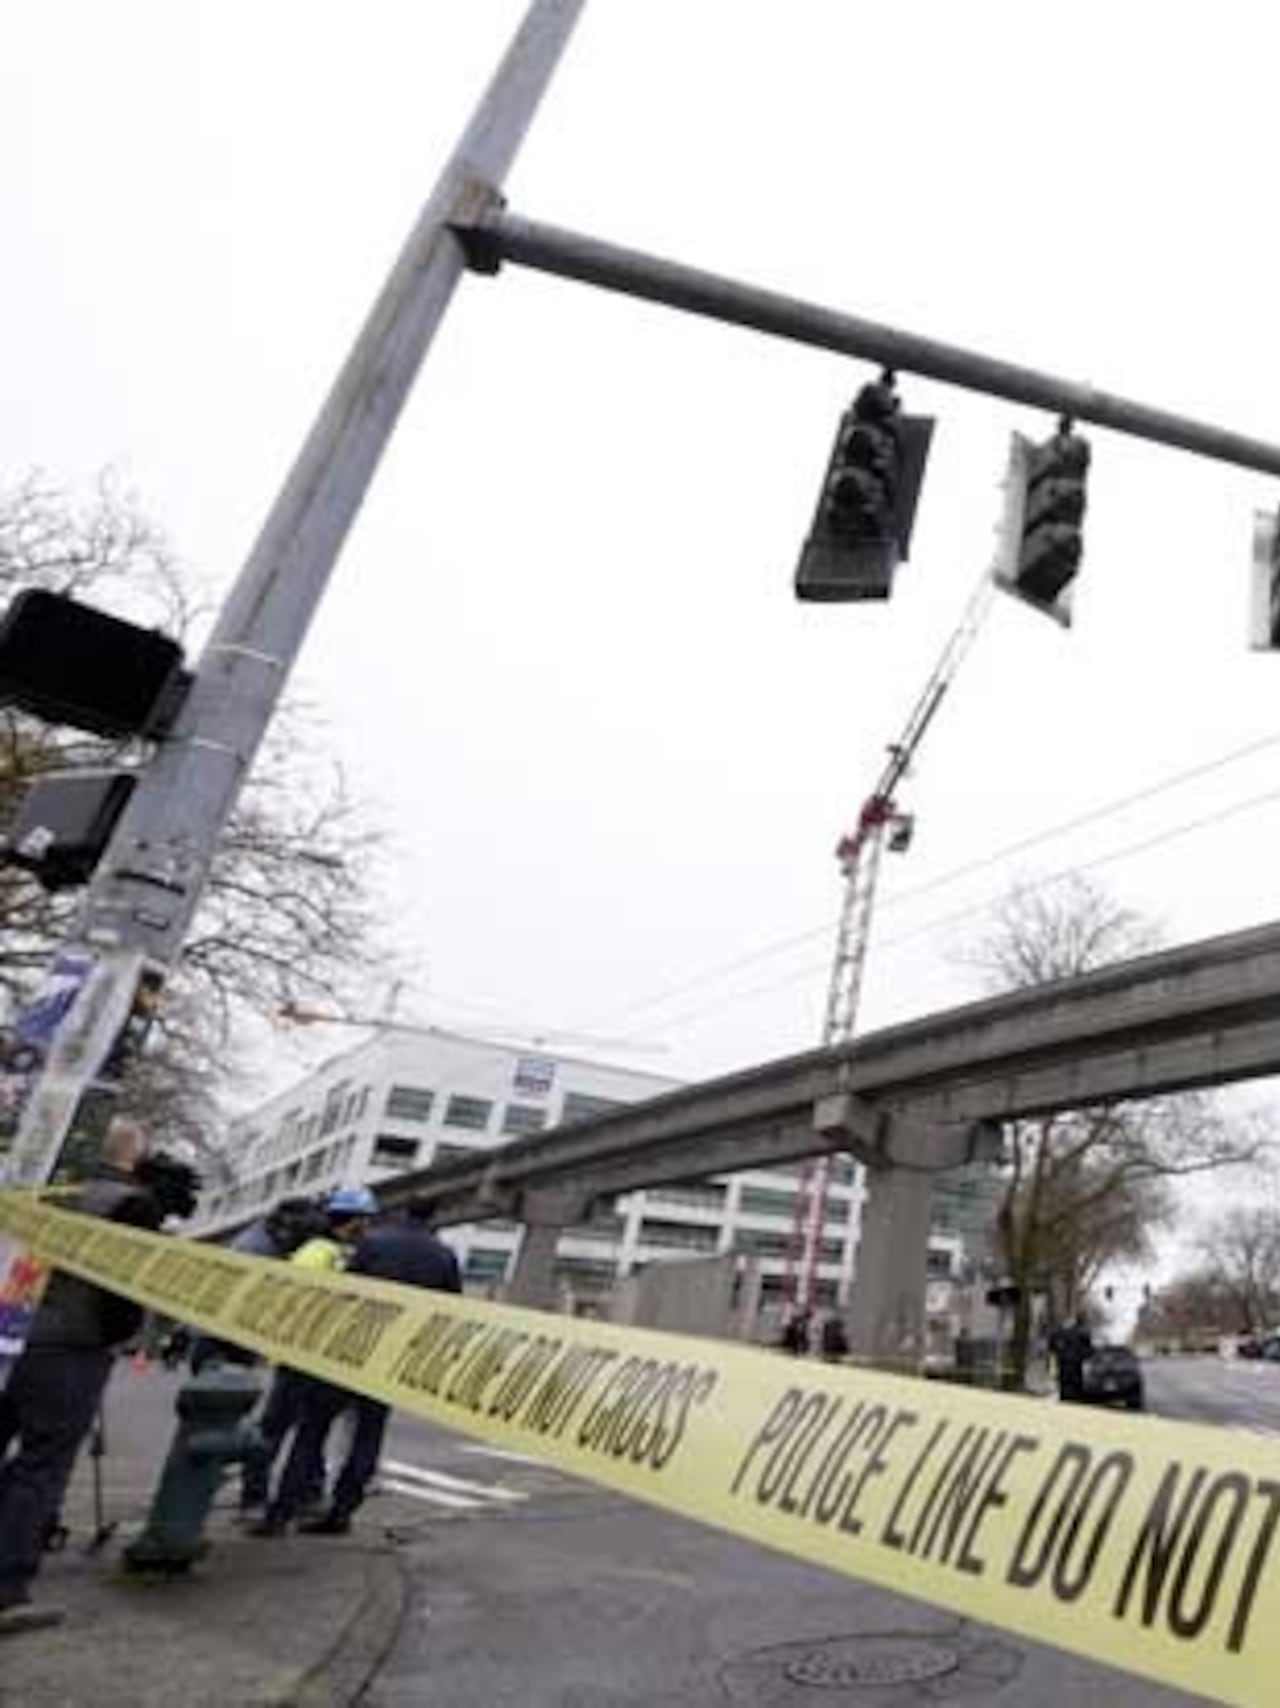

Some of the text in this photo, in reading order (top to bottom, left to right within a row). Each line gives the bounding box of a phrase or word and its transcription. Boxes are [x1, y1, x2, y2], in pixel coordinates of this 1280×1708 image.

[488, 1334, 562, 1422] DO
[520, 1344, 620, 1439] NOT
[578, 1355, 717, 1470] CROSS
[731, 1387, 918, 1535] POLICE
[881, 1418, 1039, 1576] LINE
[1005, 1441, 1134, 1605] DO
